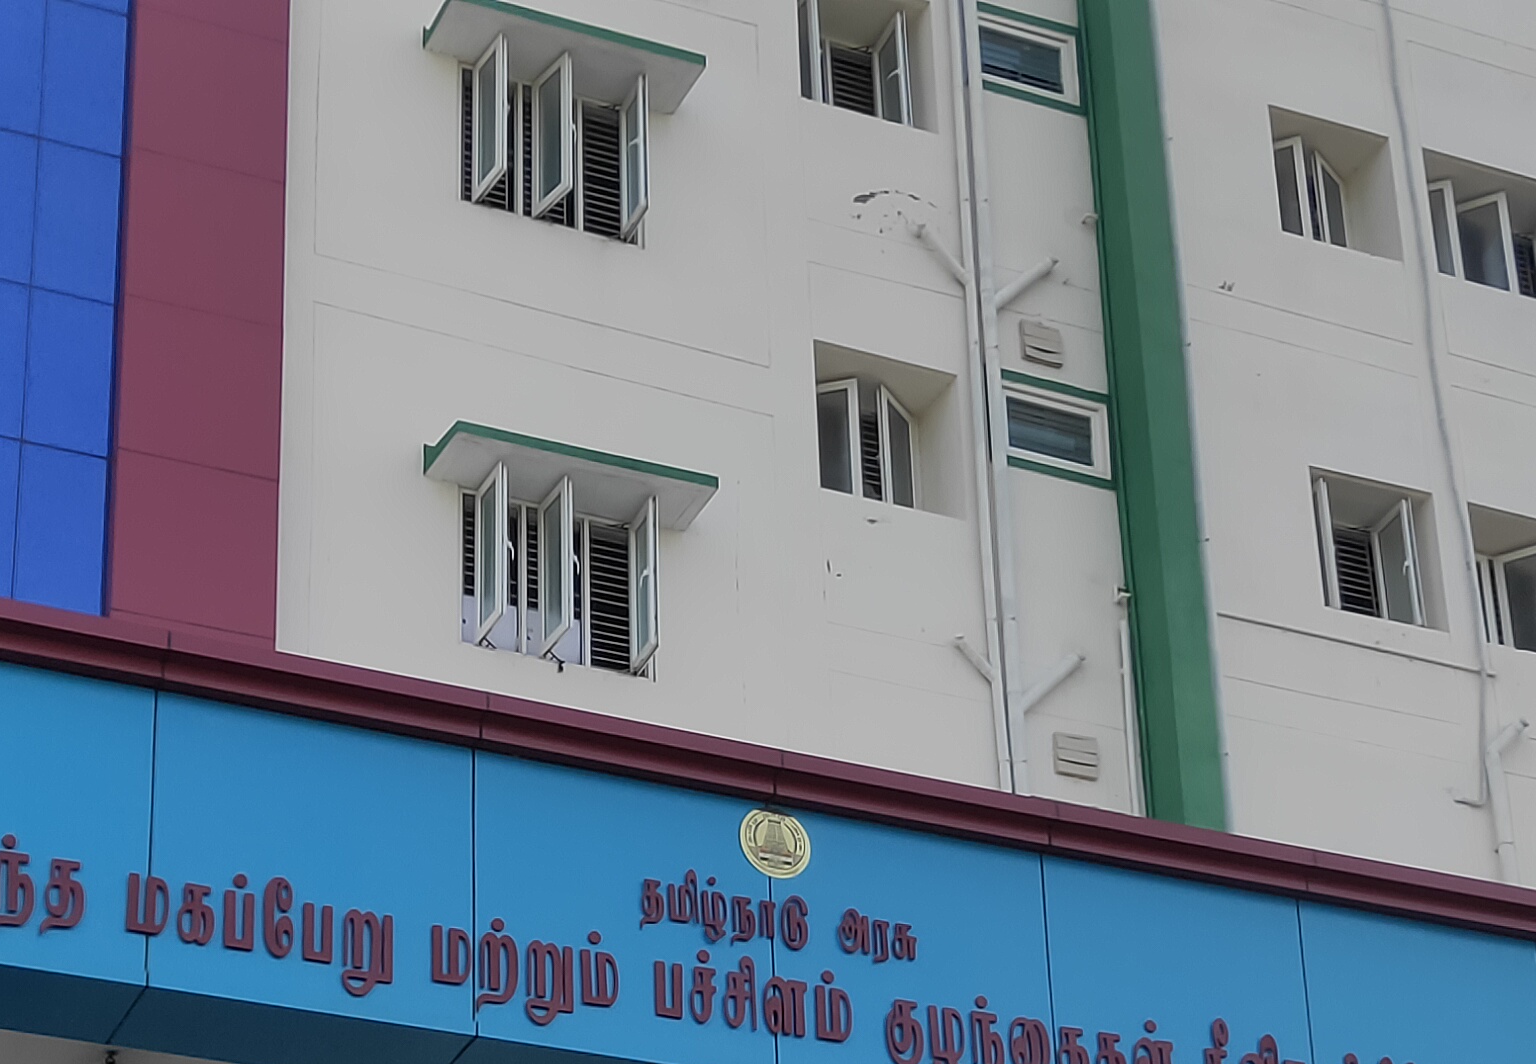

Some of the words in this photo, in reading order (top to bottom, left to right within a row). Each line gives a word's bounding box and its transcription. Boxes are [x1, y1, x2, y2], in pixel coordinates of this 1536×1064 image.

[125, 871, 395, 996] மகப்பேறு
[430, 917, 621, 1026] மற்றும்
[653, 949, 853, 1043] பச்சிளம்
[640, 868, 809, 951] தமிழ்நாடு
[837, 908, 917, 962] அரசு
